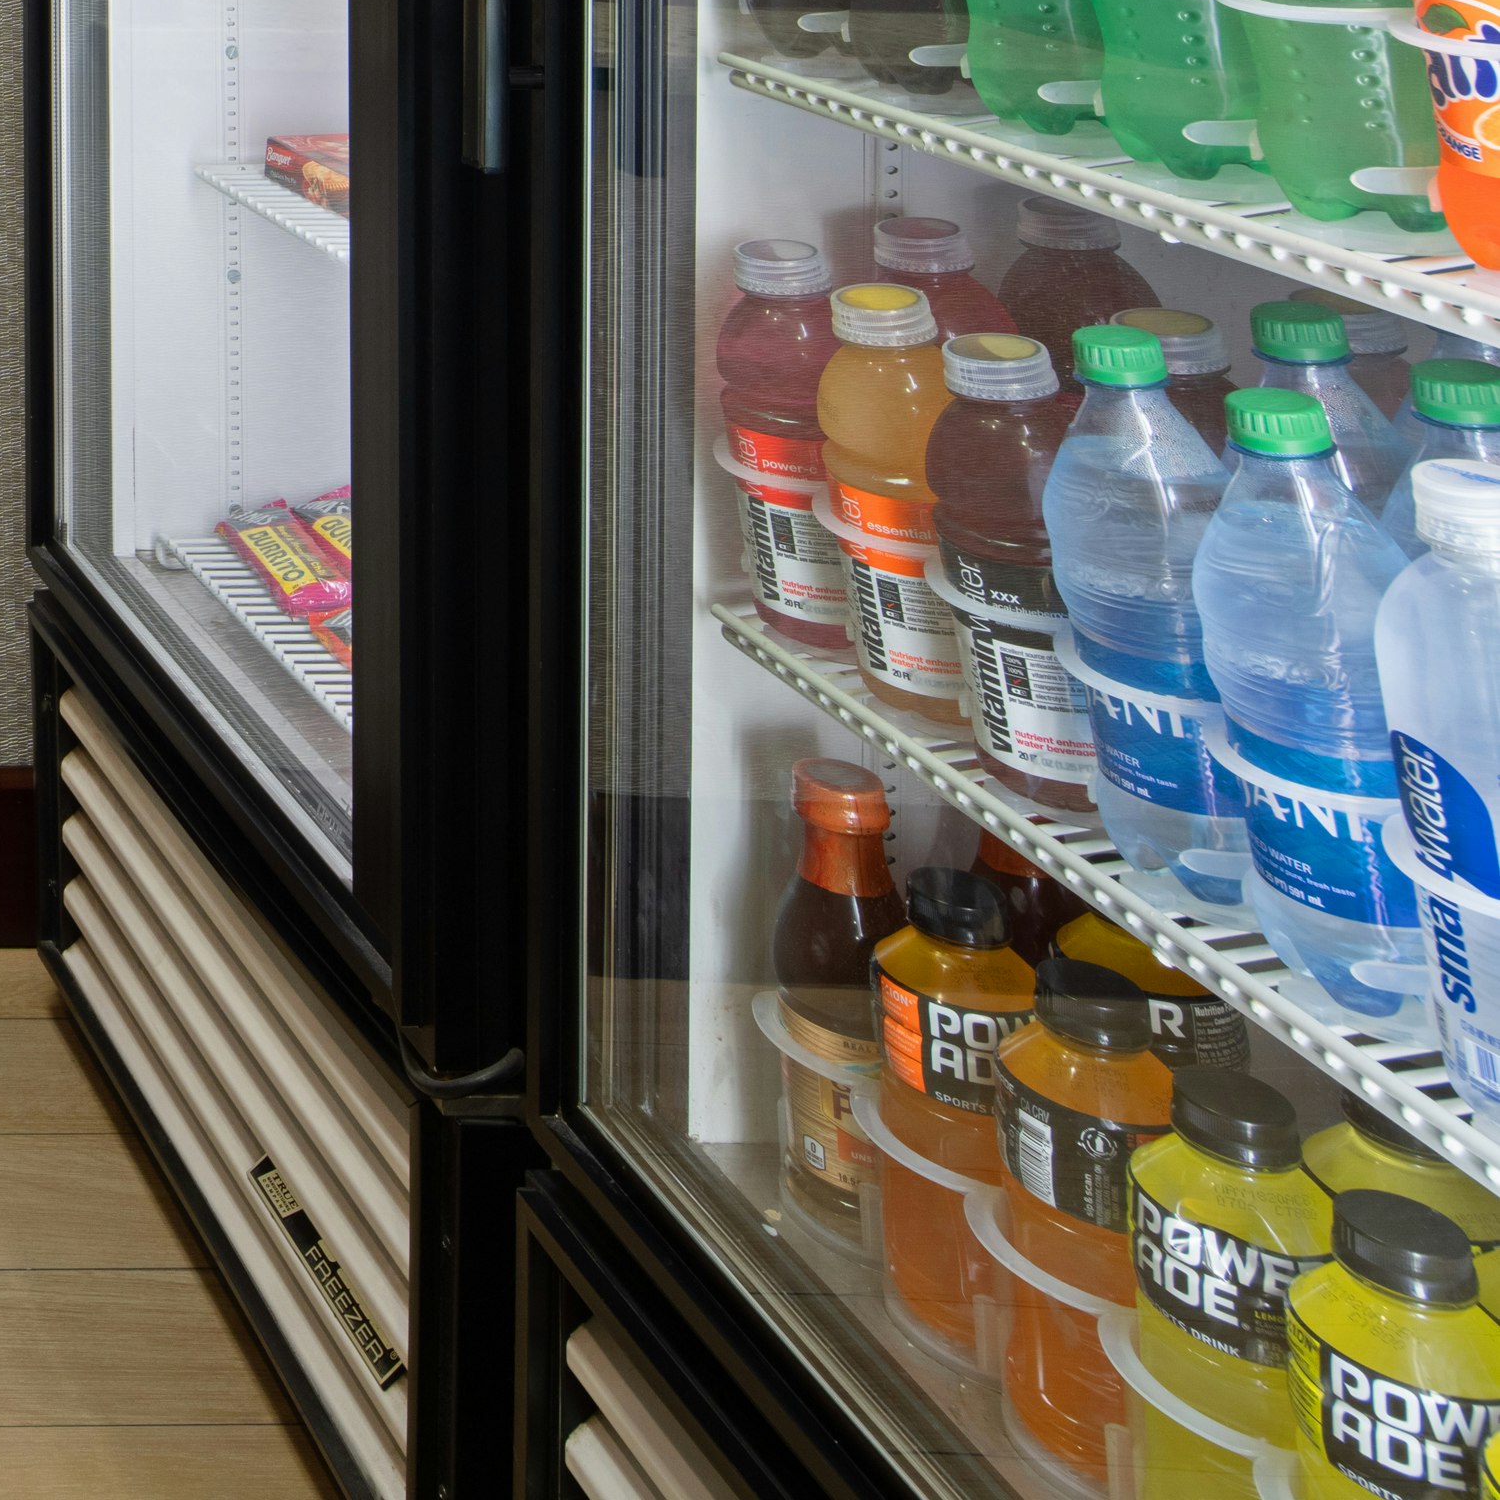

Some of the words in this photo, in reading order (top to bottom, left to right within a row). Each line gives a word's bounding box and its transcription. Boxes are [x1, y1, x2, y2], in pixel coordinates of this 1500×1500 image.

[266, 147, 292, 166] Banquet
[761, 457, 818, 475] power-c
[866, 520, 932, 541] essential
[247, 530, 305, 582] BURRITO
[781, 578, 814, 593] nutrient
[782, 586, 806, 598] water
[989, 589, 1021, 605] xxx
[888, 648, 924, 664] nutrient
[890, 656, 917, 670] water
[1003, 655, 1022, 667] 100%
[1024, 651, 1044, 660] source
[1006, 666, 1025, 677] 100%
[1014, 729, 1053, 745] nutrient
[1016, 737, 1046, 751] water
[1047, 744, 1096, 758] beverage
[1107, 743, 1141, 769] WATER
[1135, 771, 1155, 783] fresh
[1156, 778, 1178, 789] taste
[1268, 845, 1313, 876] WATER
[1289, 884, 1306, 901] 591
[1306, 875, 1330, 892] fresh
[1331, 884, 1356, 898] taste
[1194, 1005, 1225, 1018] Nutrition
[843, 1040, 872, 1052] REAL
[935, 1090, 987, 1114] SPORTS
[1020, 1097, 1031, 1114] CA
[1031, 1102, 1050, 1123] CRV
[272, 1172, 300, 1211] TRUE
[1084, 1173, 1093, 1194] scan
[262, 1178, 288, 1214] COMPANY
[1084, 1203, 1094, 1218] sip
[1138, 1192, 1297, 1298] POWE
[1138, 1233, 1241, 1328] ADE
[305, 1246, 385, 1364] FREEZER
[1191, 1327, 1241, 1359] DRINK
[1332, 1399, 1468, 1493] ADE
